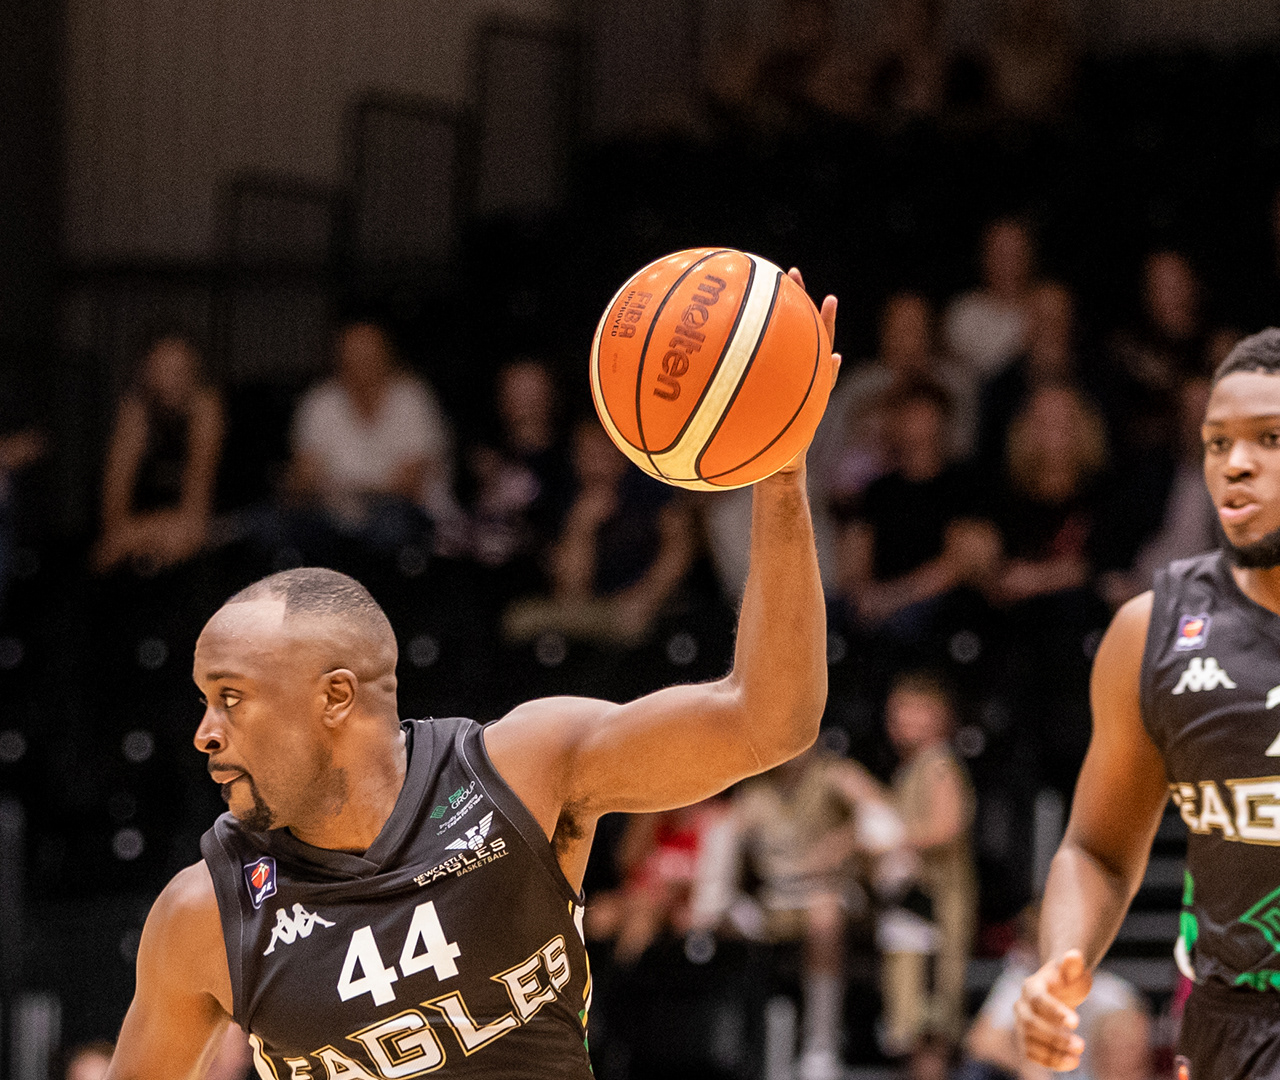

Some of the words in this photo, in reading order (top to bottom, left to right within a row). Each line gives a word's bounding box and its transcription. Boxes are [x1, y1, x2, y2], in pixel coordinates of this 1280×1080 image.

[618, 291, 654, 339] FIBA
[652, 274, 727, 402] molten
[447, 785, 465, 804] ESH
[451, 780, 476, 810] GROUP
[413, 852, 465, 883] NEWCASTLE
[417, 837, 506, 887] EAGLES
[456, 849, 509, 877] BASKETBALL
[336, 900, 462, 1007] 44
